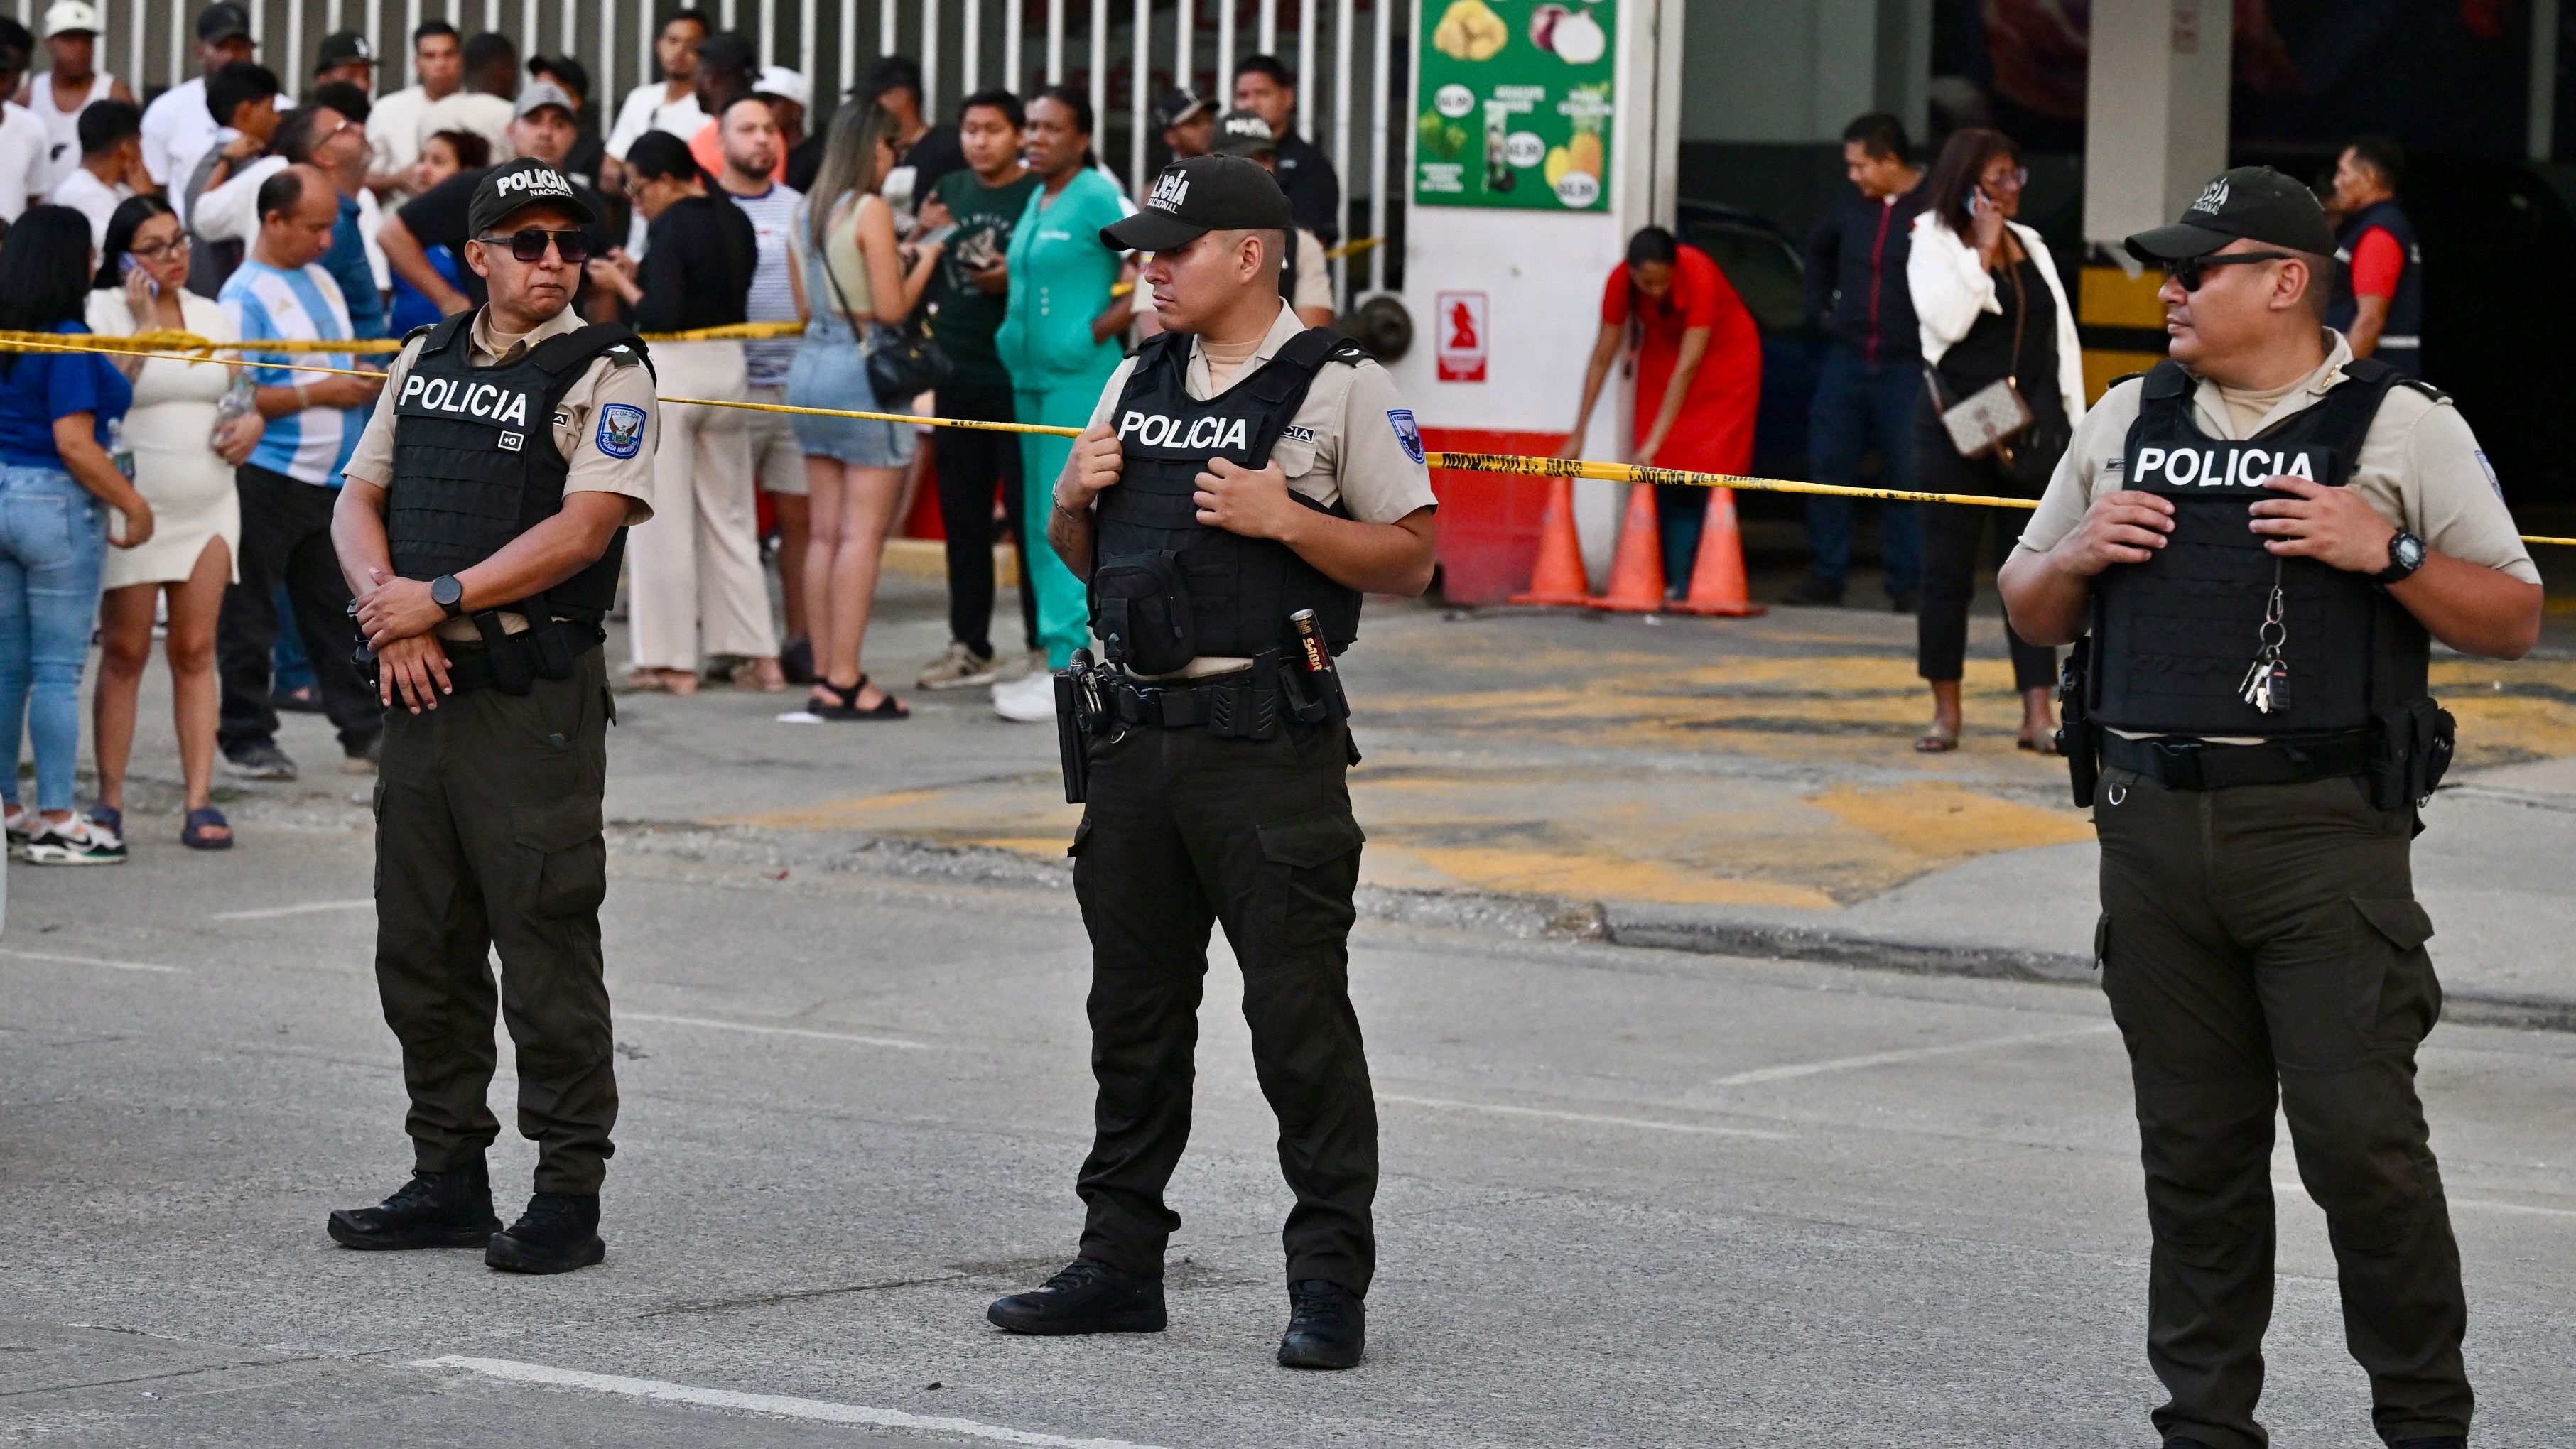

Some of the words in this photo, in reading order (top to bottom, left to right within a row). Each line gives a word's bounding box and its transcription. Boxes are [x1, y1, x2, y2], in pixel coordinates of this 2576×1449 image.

[399, 375, 526, 427] POLICIA
[611, 410, 639, 420] ECUADOR
[602, 433, 617, 452] POLICIA
[1117, 411, 1246, 450] POLICIA
[2133, 447, 2315, 488] POLICIA
[1301, 637, 1323, 671] SABR
